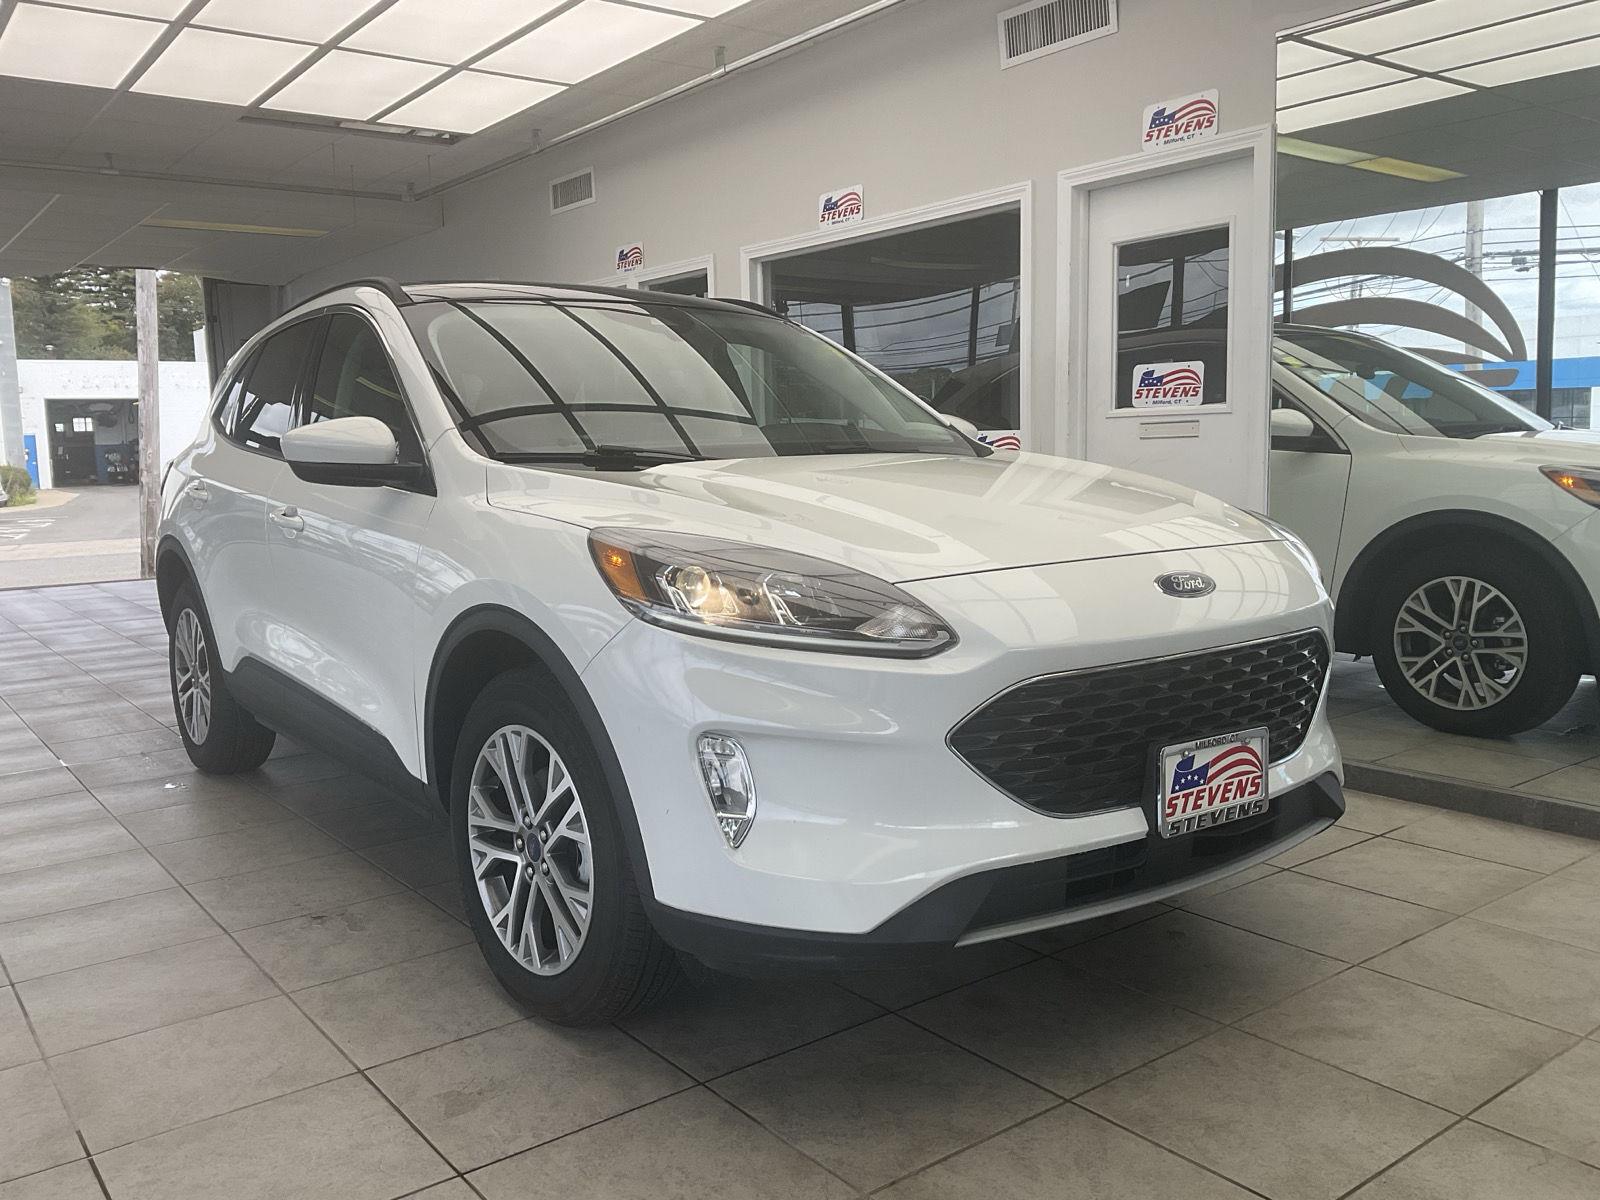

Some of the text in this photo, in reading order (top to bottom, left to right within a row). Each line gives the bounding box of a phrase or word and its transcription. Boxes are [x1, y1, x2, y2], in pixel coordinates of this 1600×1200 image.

[1144, 115, 1216, 143] STEVENS
[820, 204, 861, 222] STEVENS
[616, 258, 642, 270] STEVENS
[1134, 386, 1201, 399] STEVENS
[1171, 574, 1204, 590] Ford
[1166, 774, 1263, 818] STEVENS
[1167, 800, 1263, 836] STEVENS
